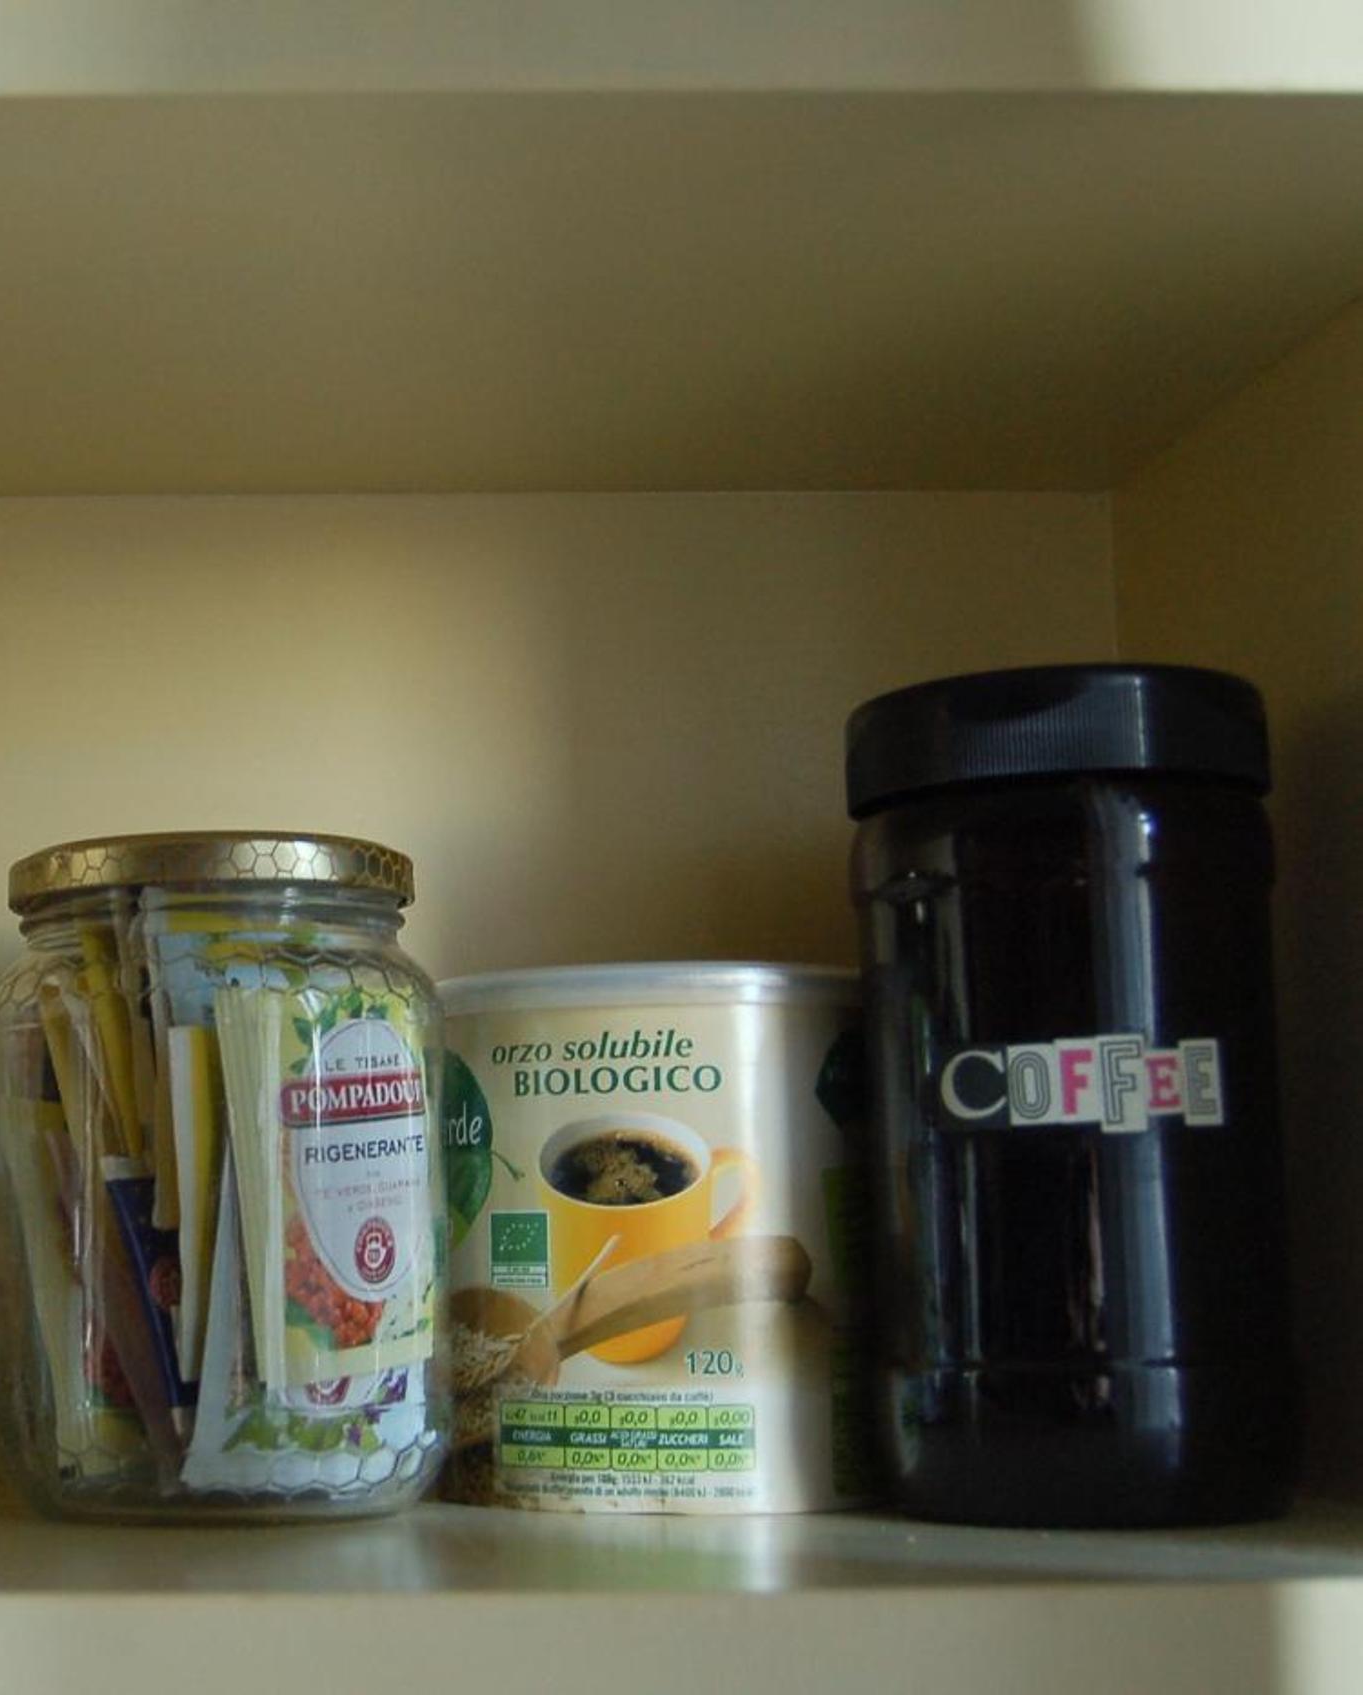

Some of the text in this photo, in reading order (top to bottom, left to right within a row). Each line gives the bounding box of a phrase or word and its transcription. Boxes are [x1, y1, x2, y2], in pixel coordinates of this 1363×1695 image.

[492, 1029, 693, 1065] orzo solubile
[324, 1057, 347, 1073] LE
[513, 1064, 722, 1097] BIOLOGICO
[940, 1039, 1220, 1126] COFFEE
[569, 1431, 607, 1445] GRASSI
[658, 1431, 709, 1446] ZUCCHERI
[719, 1432, 745, 1446] SALE
